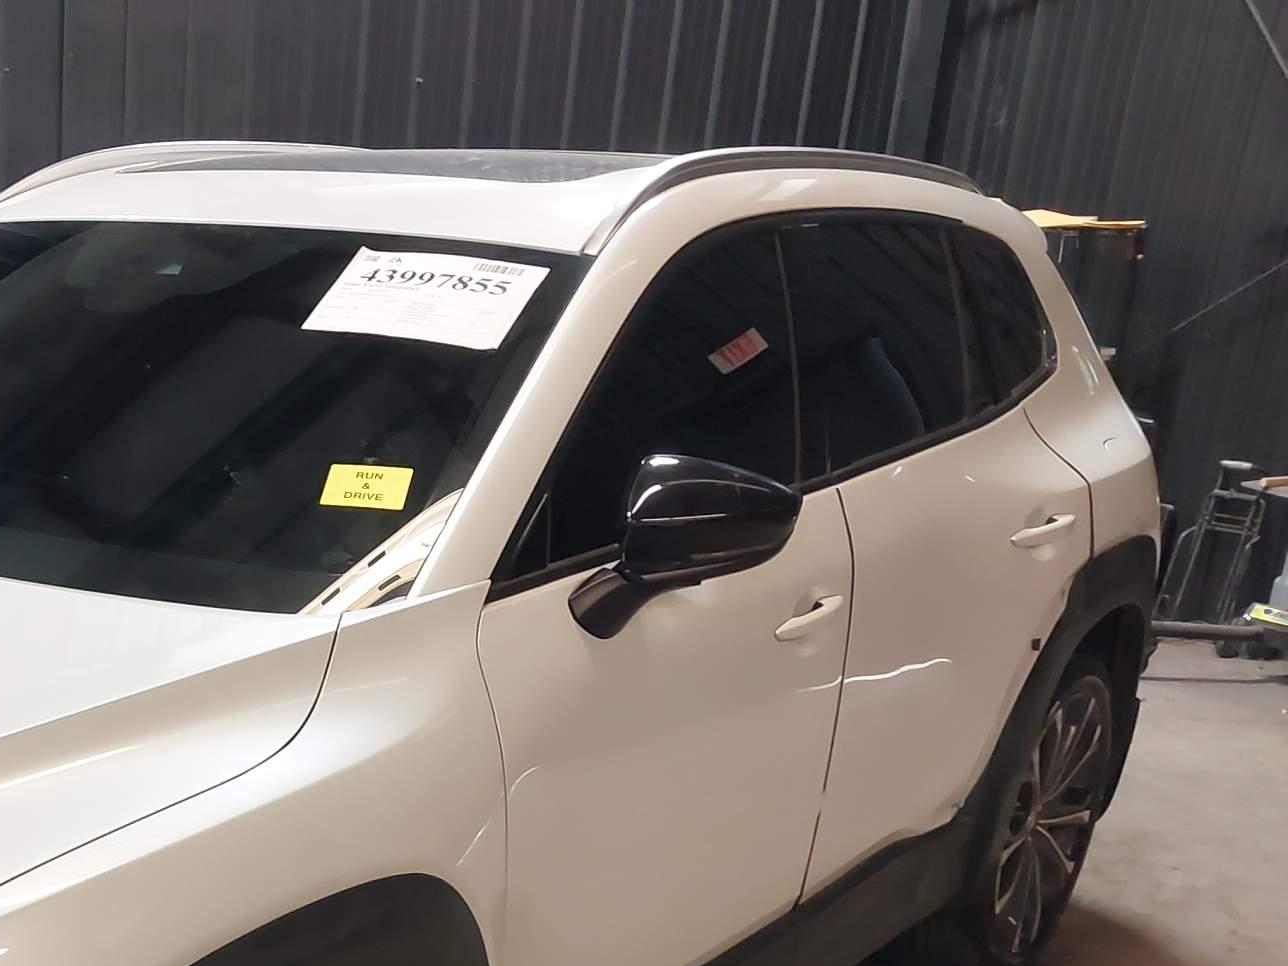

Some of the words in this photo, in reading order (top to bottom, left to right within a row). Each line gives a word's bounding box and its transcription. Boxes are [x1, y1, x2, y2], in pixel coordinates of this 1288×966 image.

[359, 267, 513, 296] 43997855
[355, 471, 384, 481] RUN
[361, 482, 370, 490] &
[343, 491, 384, 501] DRIVE
